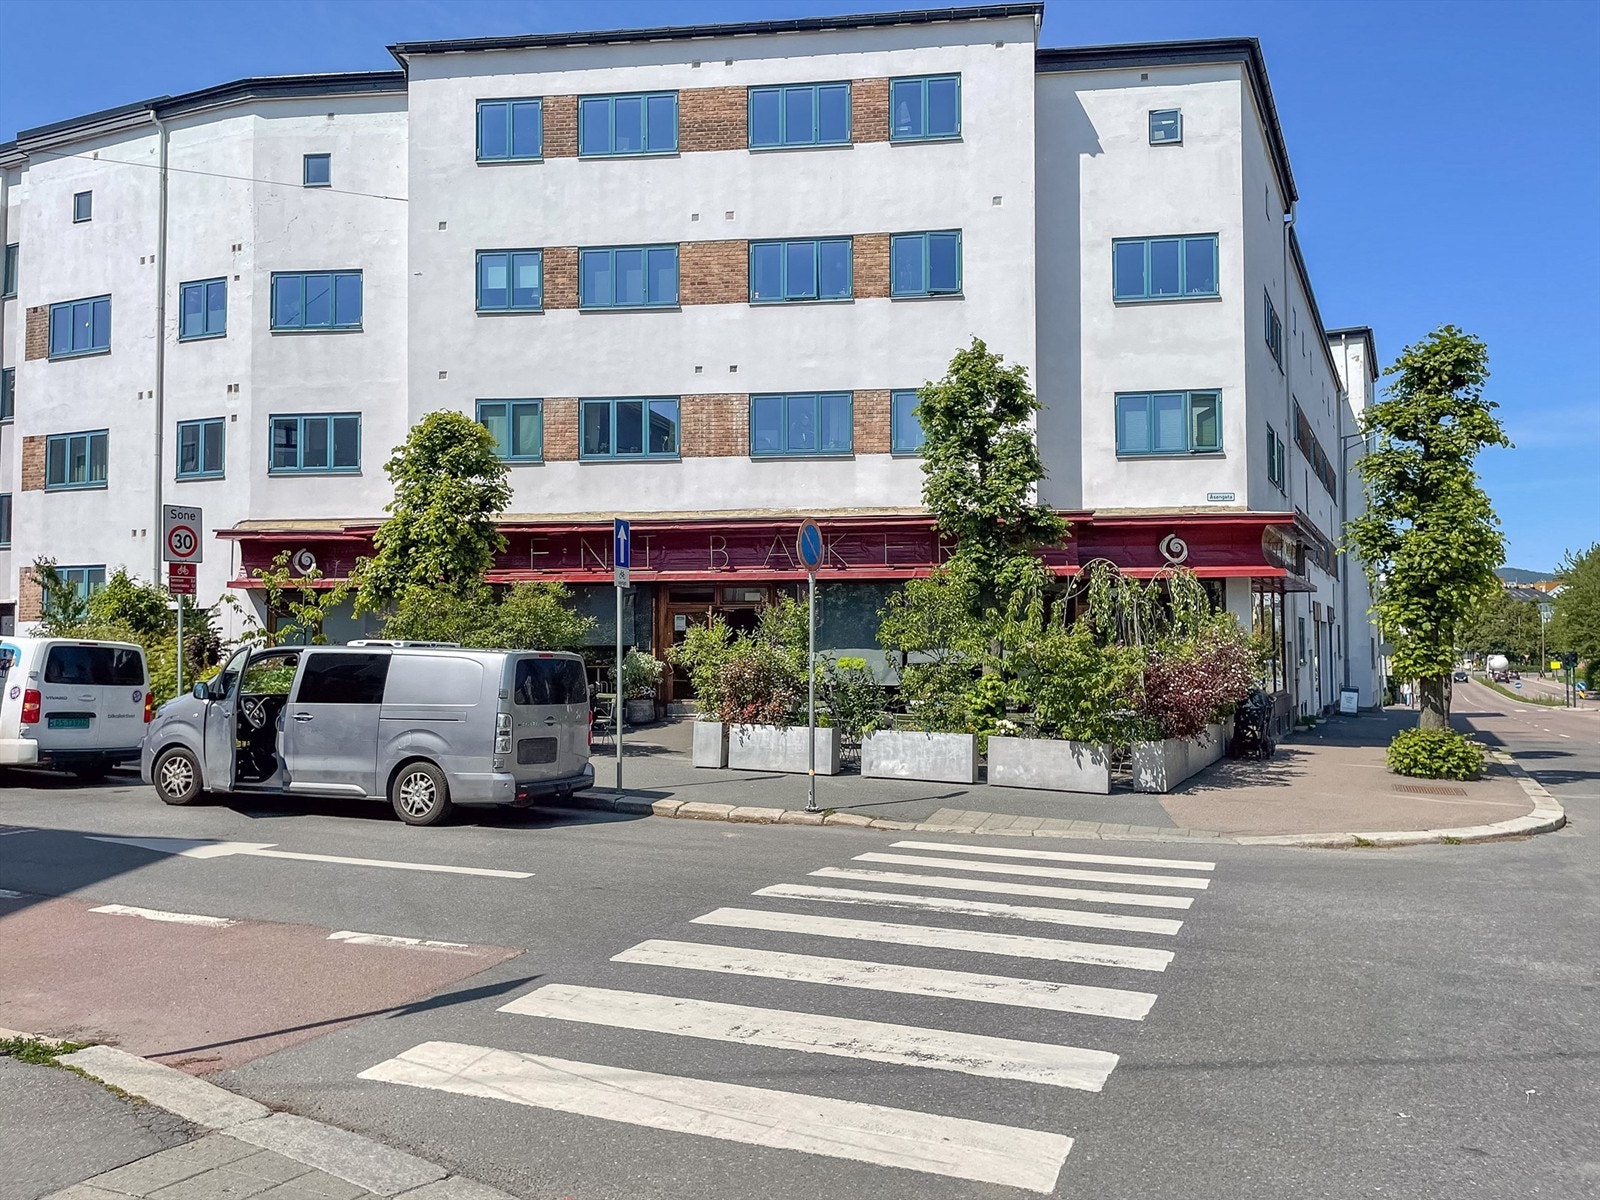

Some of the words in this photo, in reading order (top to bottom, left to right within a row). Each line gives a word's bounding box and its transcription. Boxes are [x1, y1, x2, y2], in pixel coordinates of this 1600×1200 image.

[170, 509, 196, 521] Sone
[174, 533, 193, 550] 30
[710, 531, 961, 570] BAKER
